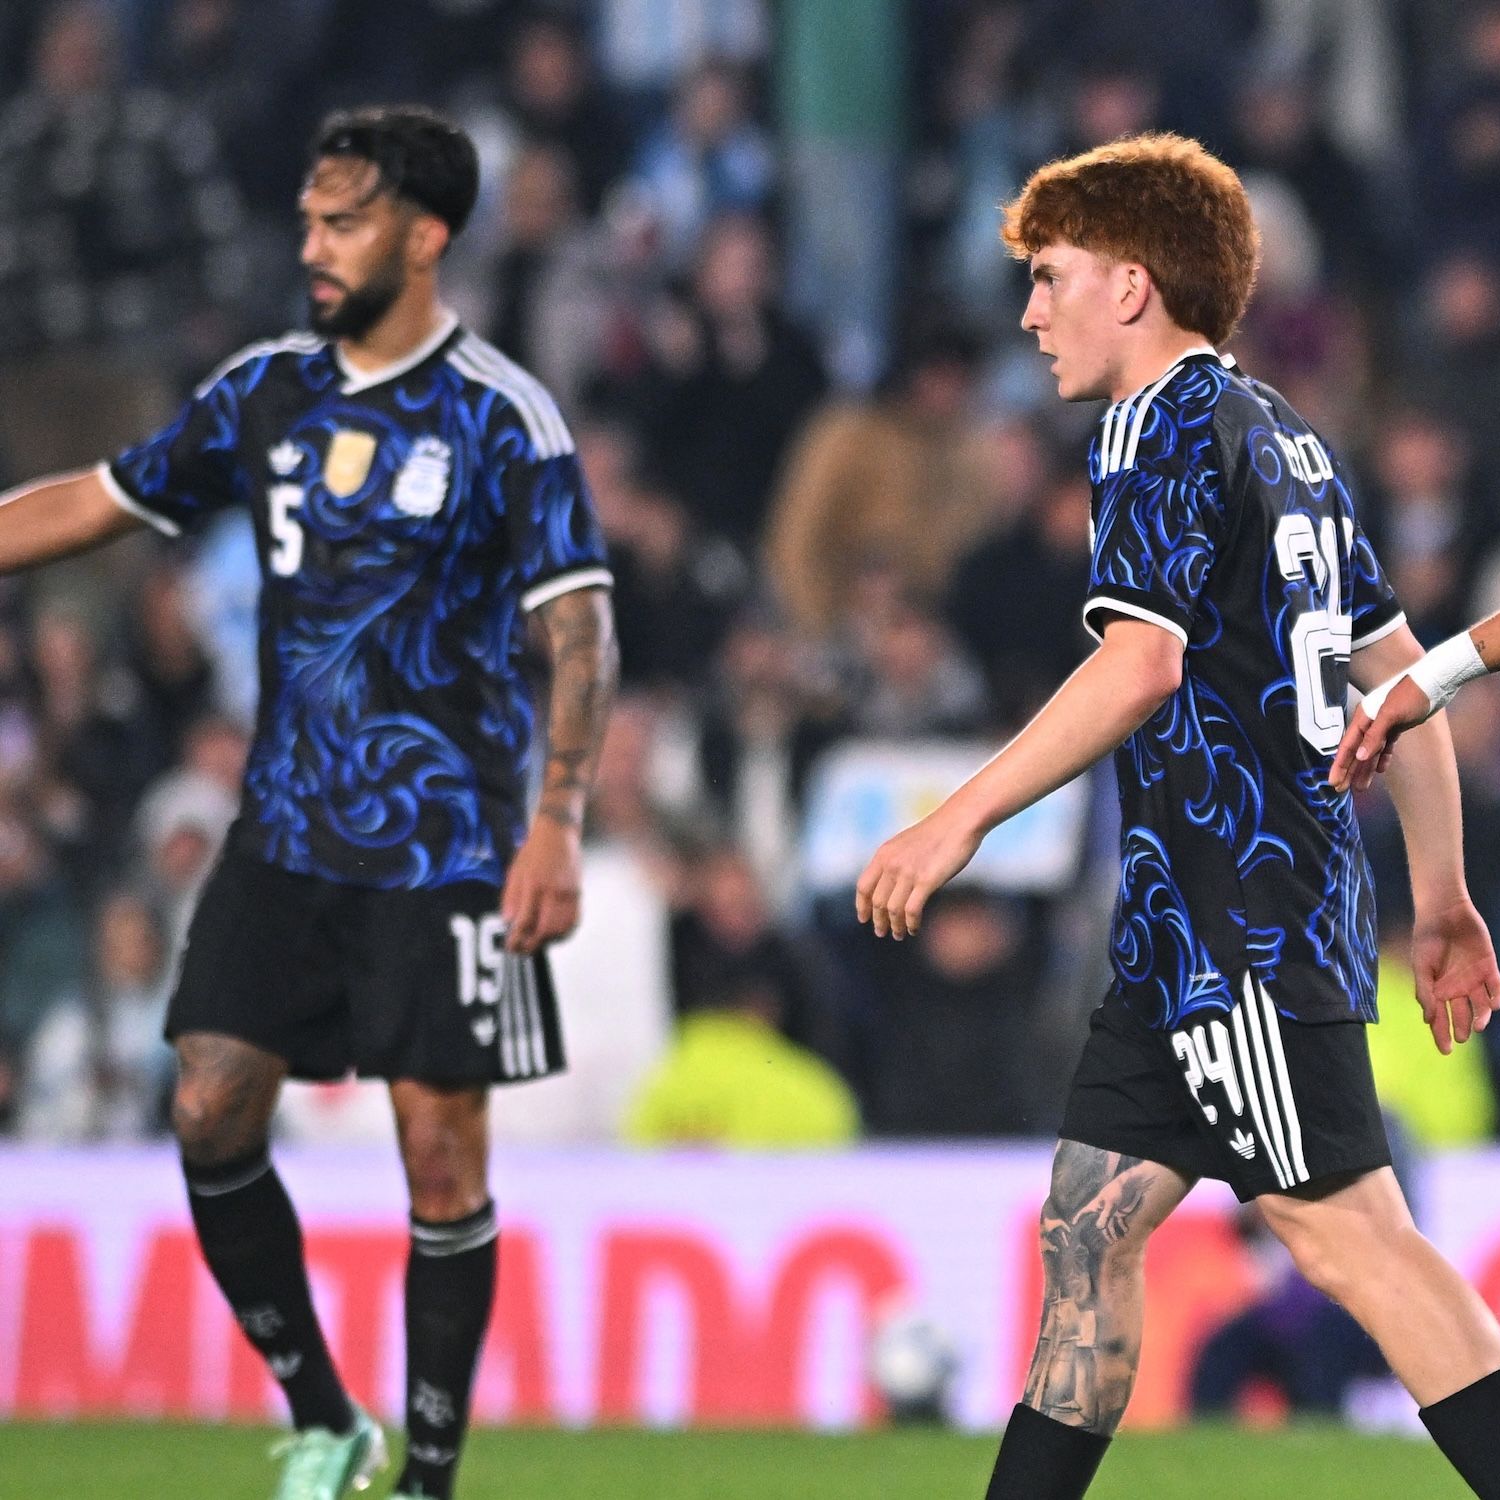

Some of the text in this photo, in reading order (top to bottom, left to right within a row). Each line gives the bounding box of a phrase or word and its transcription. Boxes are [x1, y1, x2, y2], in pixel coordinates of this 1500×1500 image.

[268, 484, 305, 578] 5
[450, 913, 507, 1007] 15
[1171, 1020, 1244, 1126] 24
